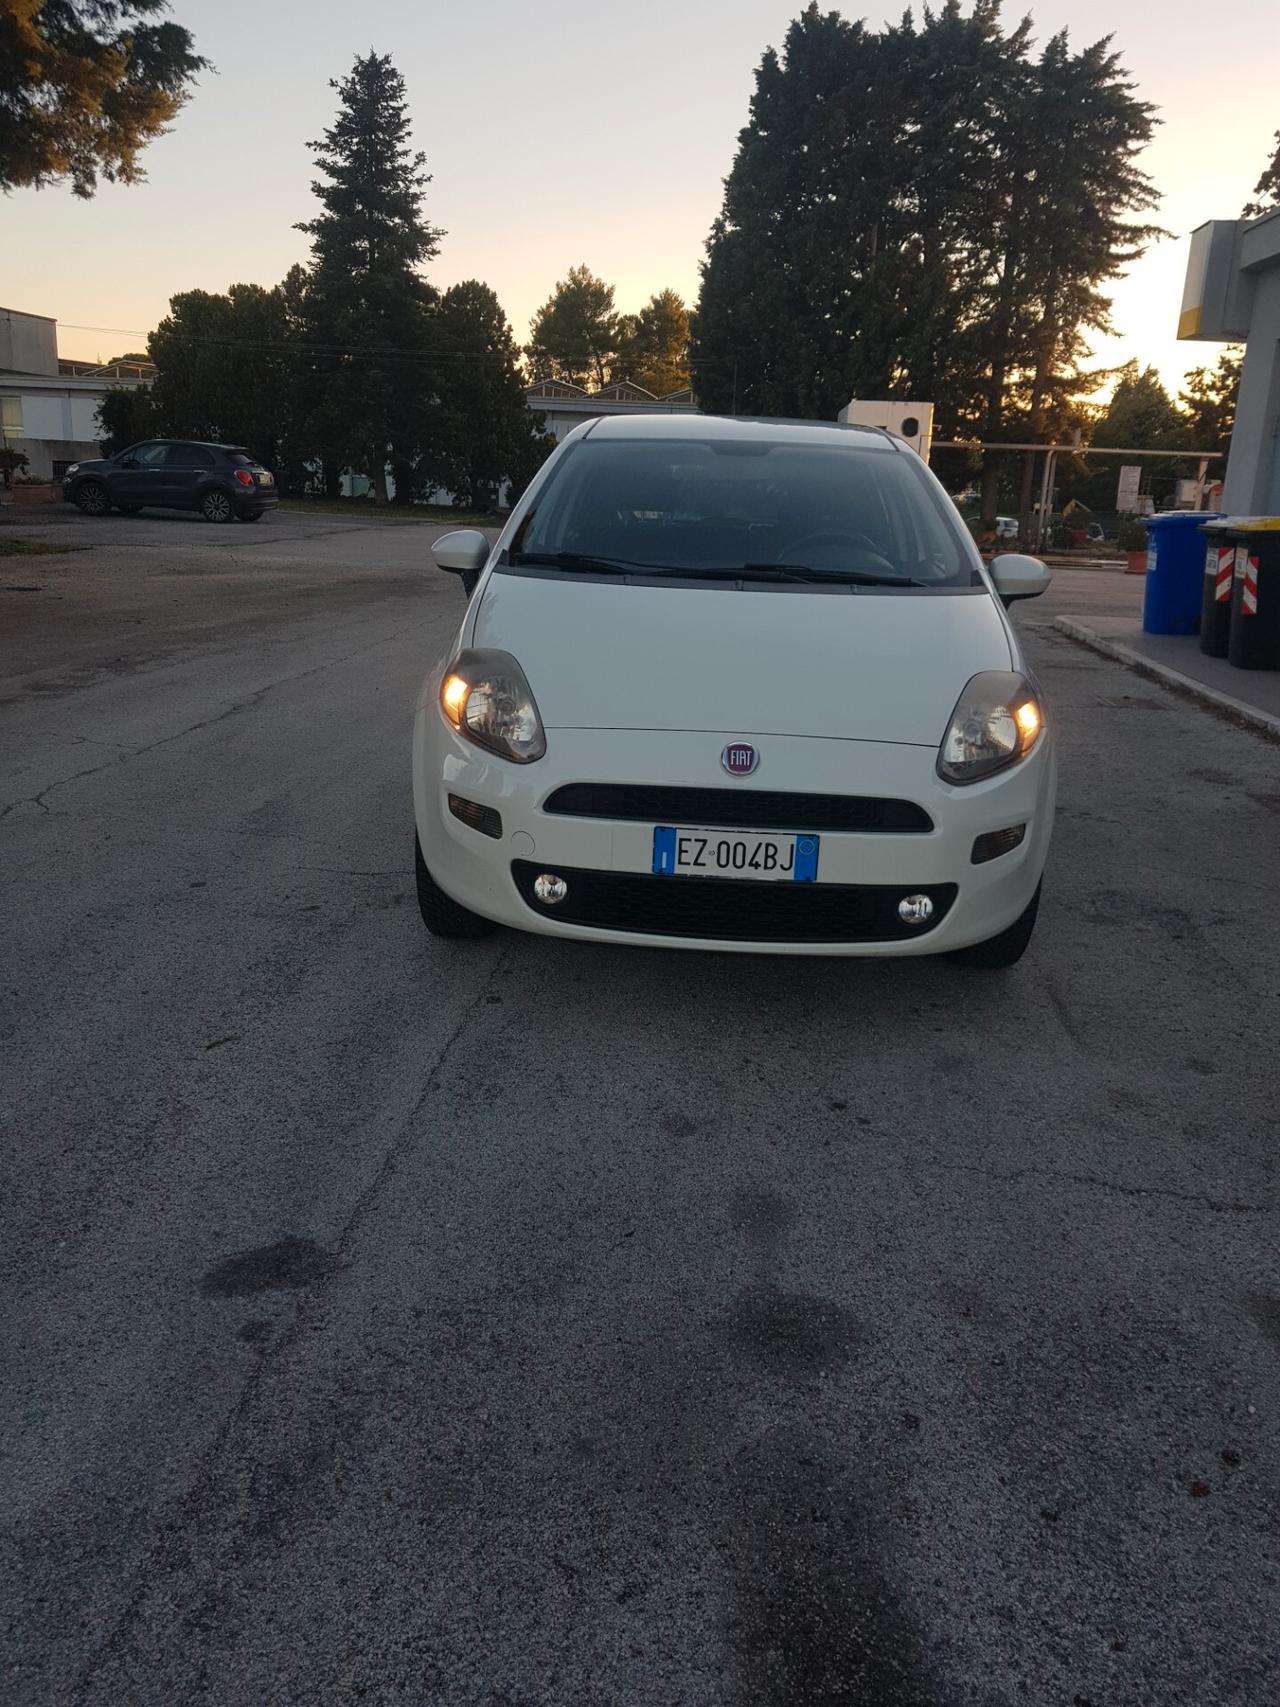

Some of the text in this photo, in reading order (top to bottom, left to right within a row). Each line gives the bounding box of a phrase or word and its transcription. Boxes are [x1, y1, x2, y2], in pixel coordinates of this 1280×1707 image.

[730, 750, 752, 766] FIAT
[677, 838, 795, 871] EZ 004BJ
